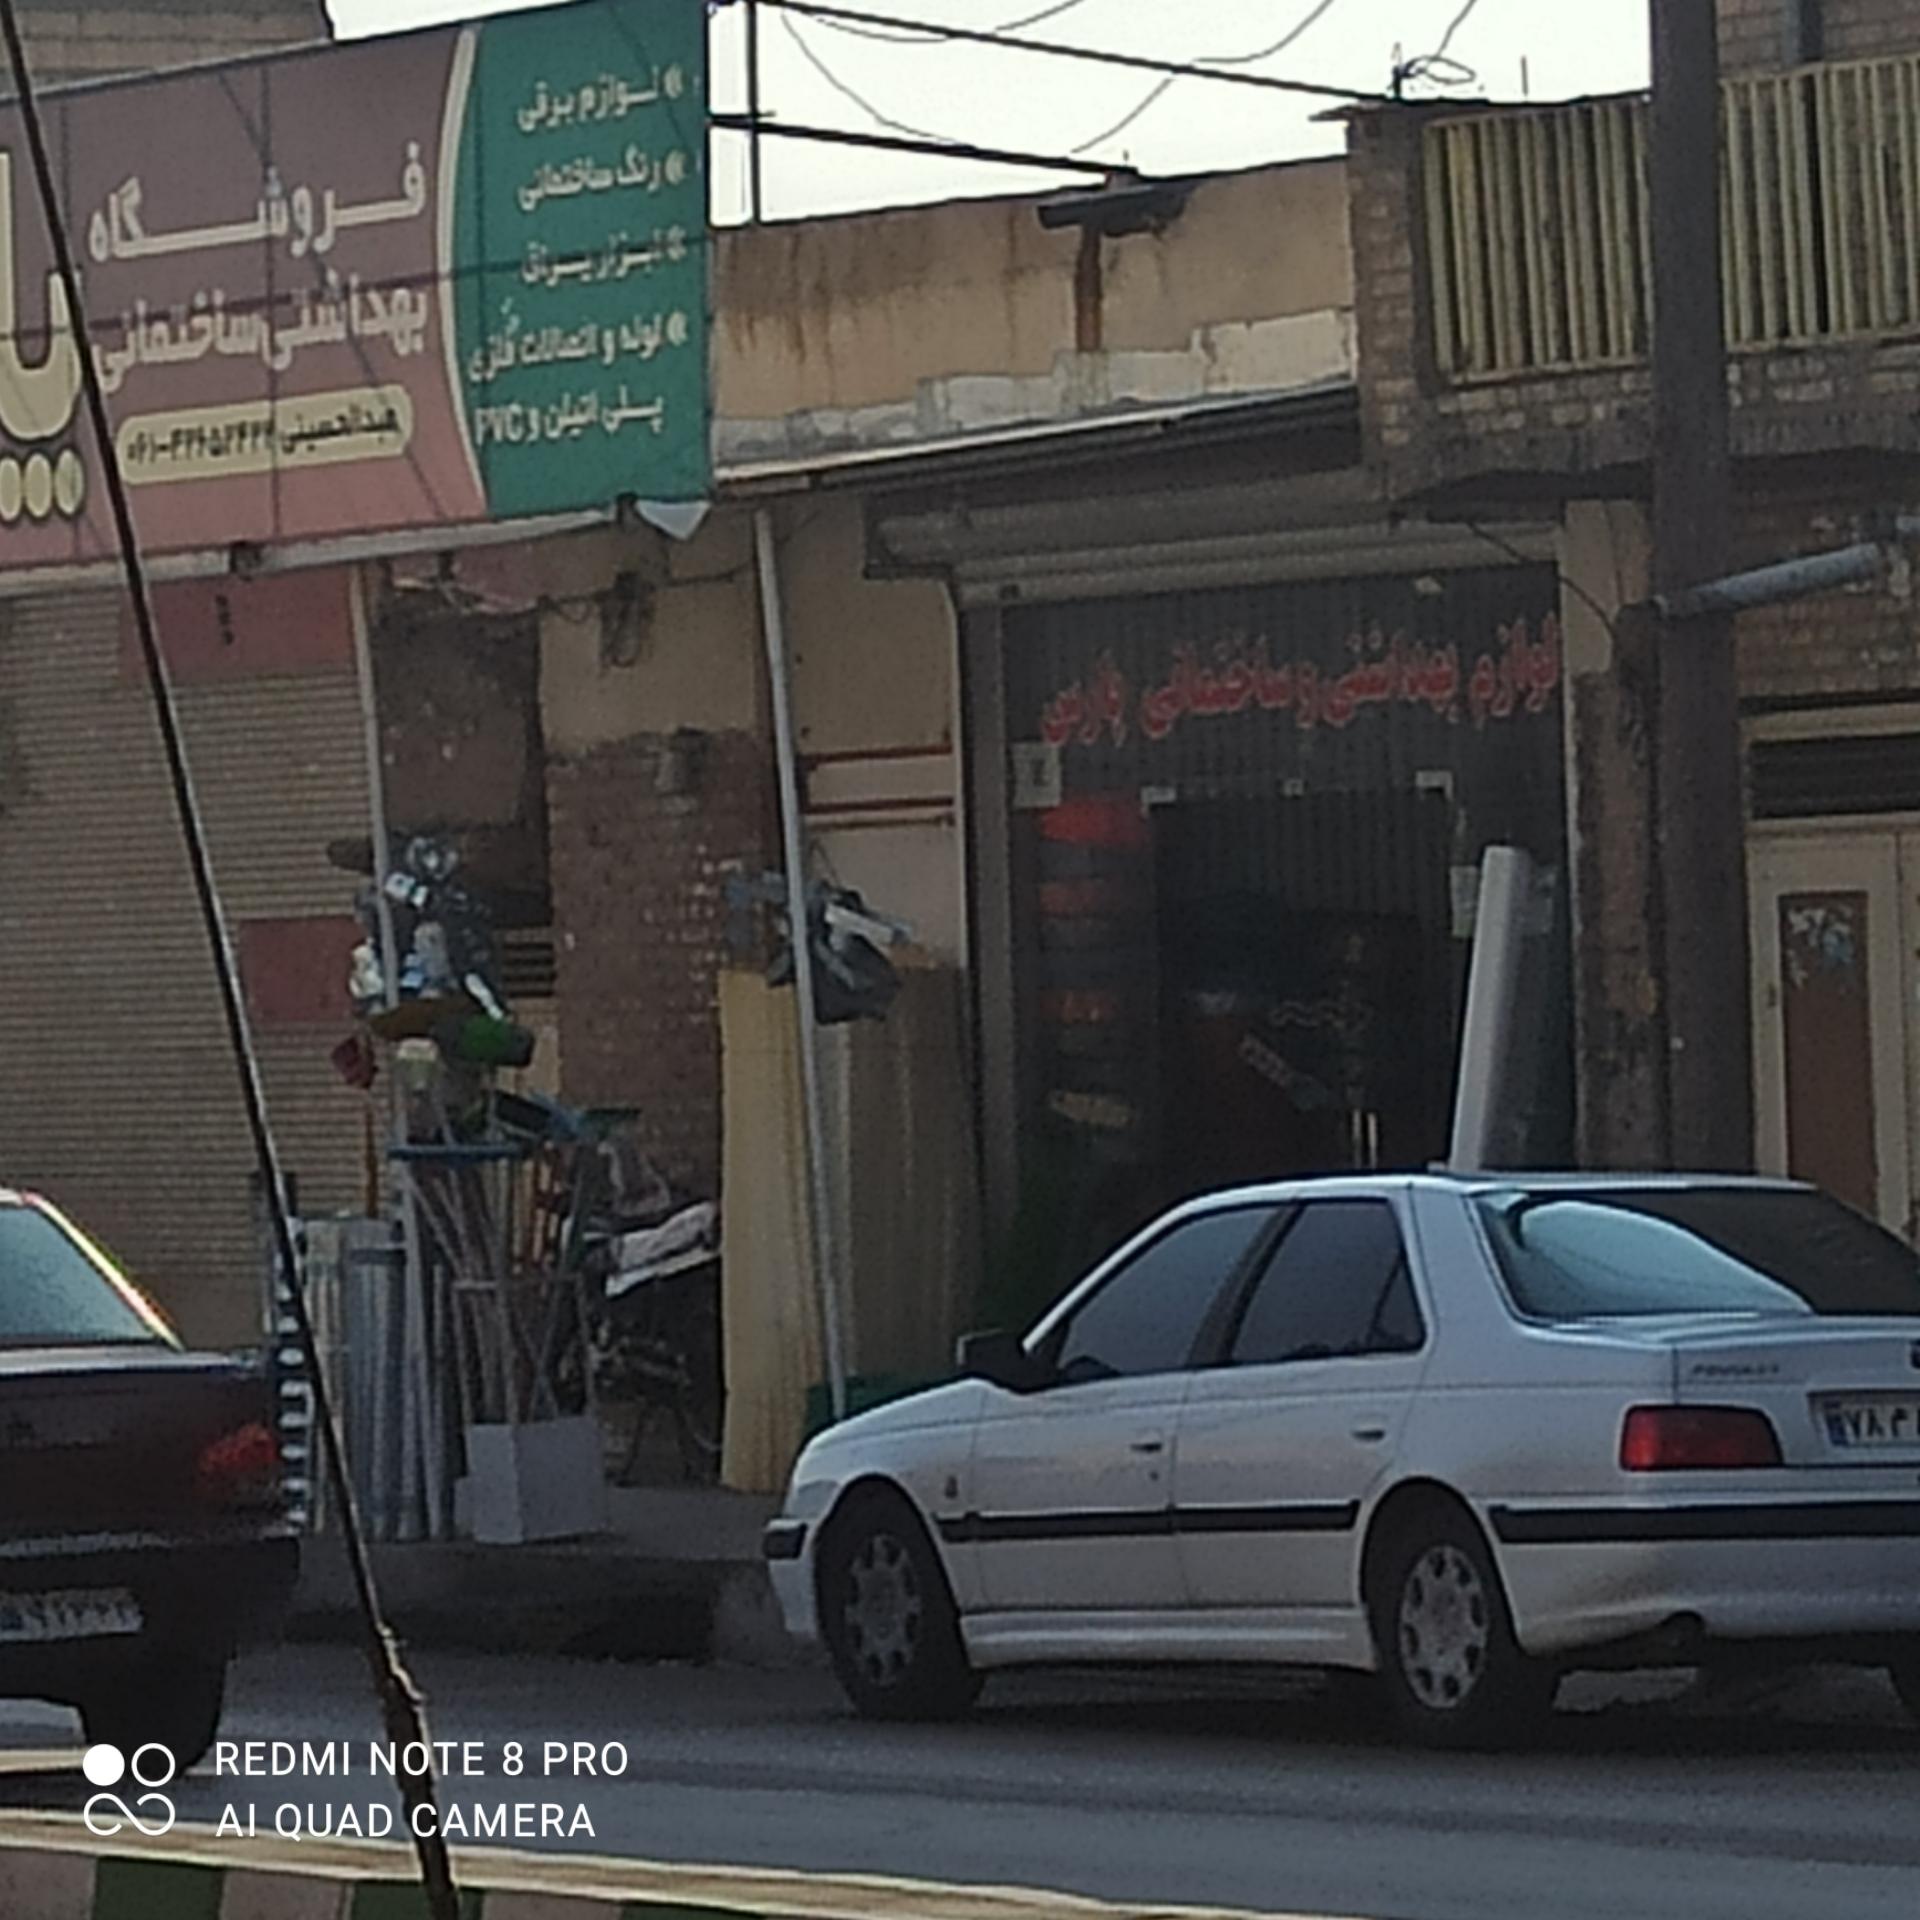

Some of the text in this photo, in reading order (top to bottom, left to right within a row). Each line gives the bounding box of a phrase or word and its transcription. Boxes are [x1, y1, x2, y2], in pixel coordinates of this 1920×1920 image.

[577, 64, 659, 123] لوازم
[89, 142, 426, 263] فروشگاه
[474, 402, 523, 446] PVC
